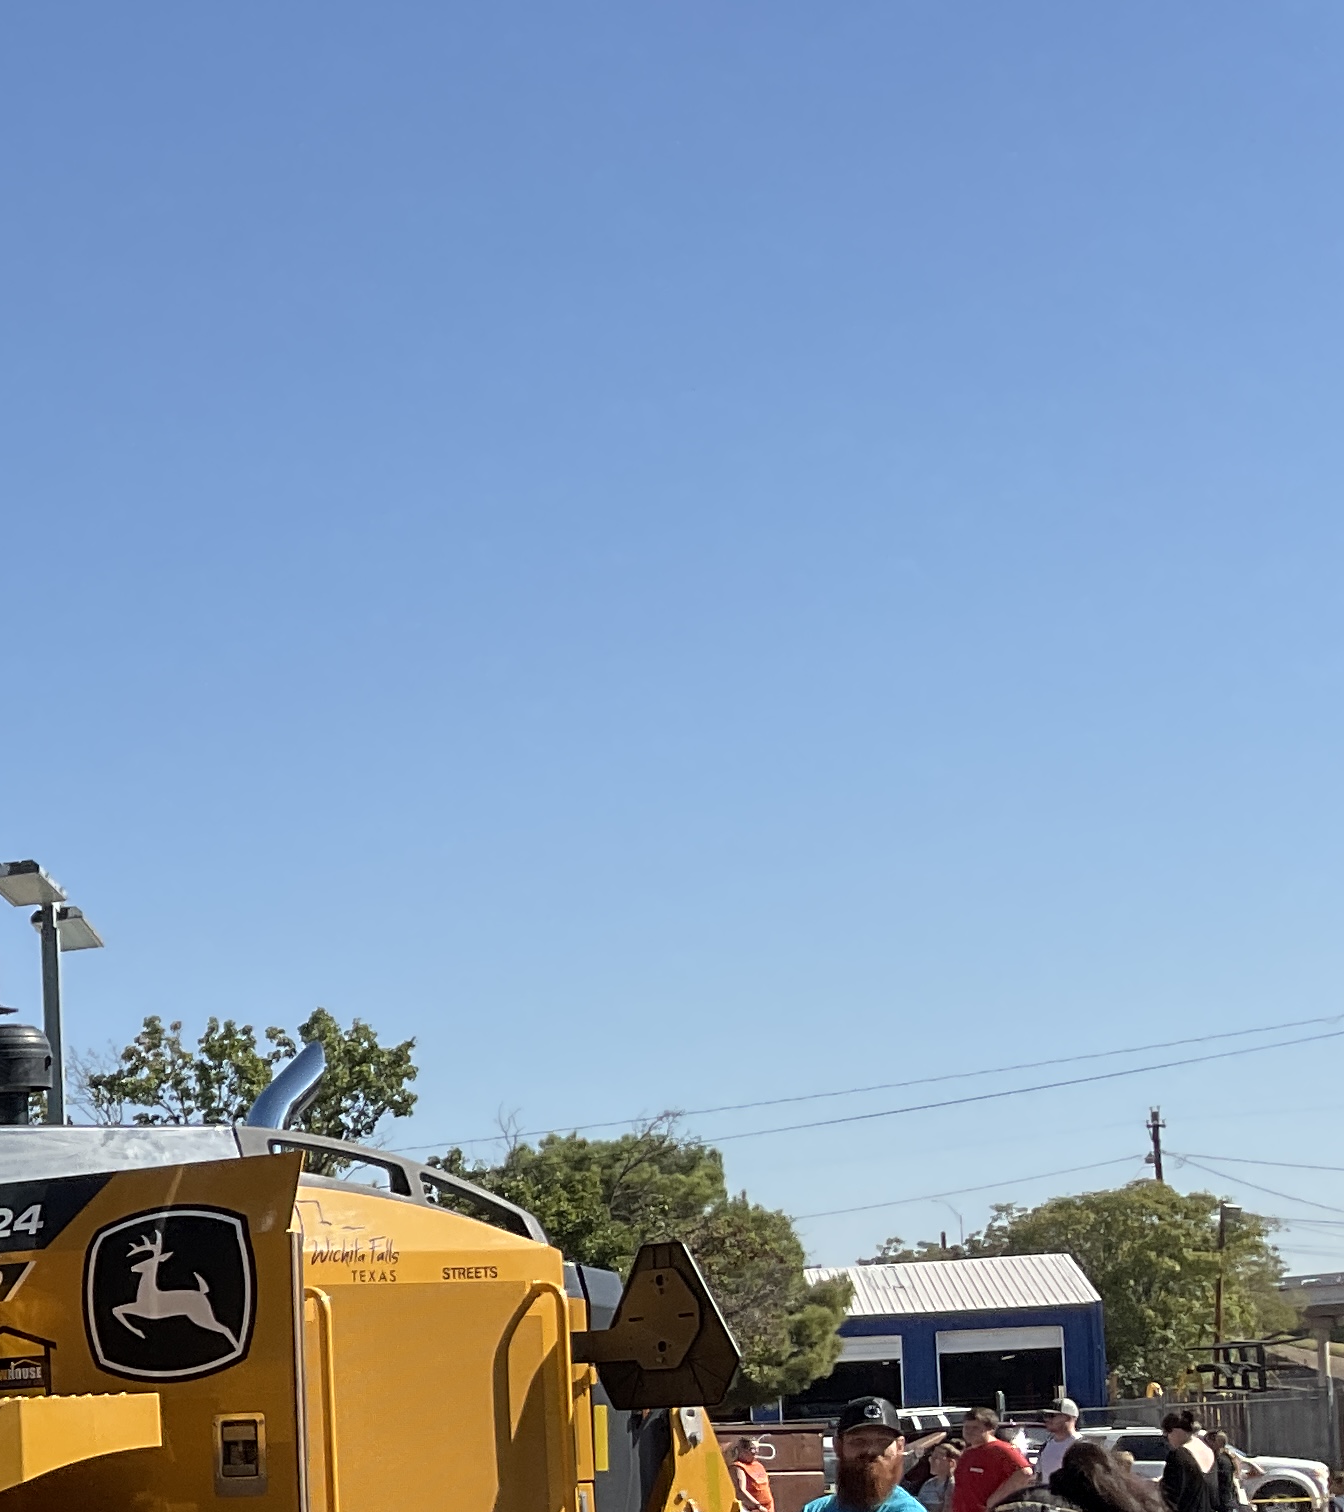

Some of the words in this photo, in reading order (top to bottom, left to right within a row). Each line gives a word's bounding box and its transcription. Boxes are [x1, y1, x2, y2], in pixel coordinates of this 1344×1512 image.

[311, 1236, 365, 1266] Wichita
[369, 1235, 400, 1265] Falls
[351, 1269, 397, 1283] TEXAS
[442, 1266, 498, 1281] STREETS
